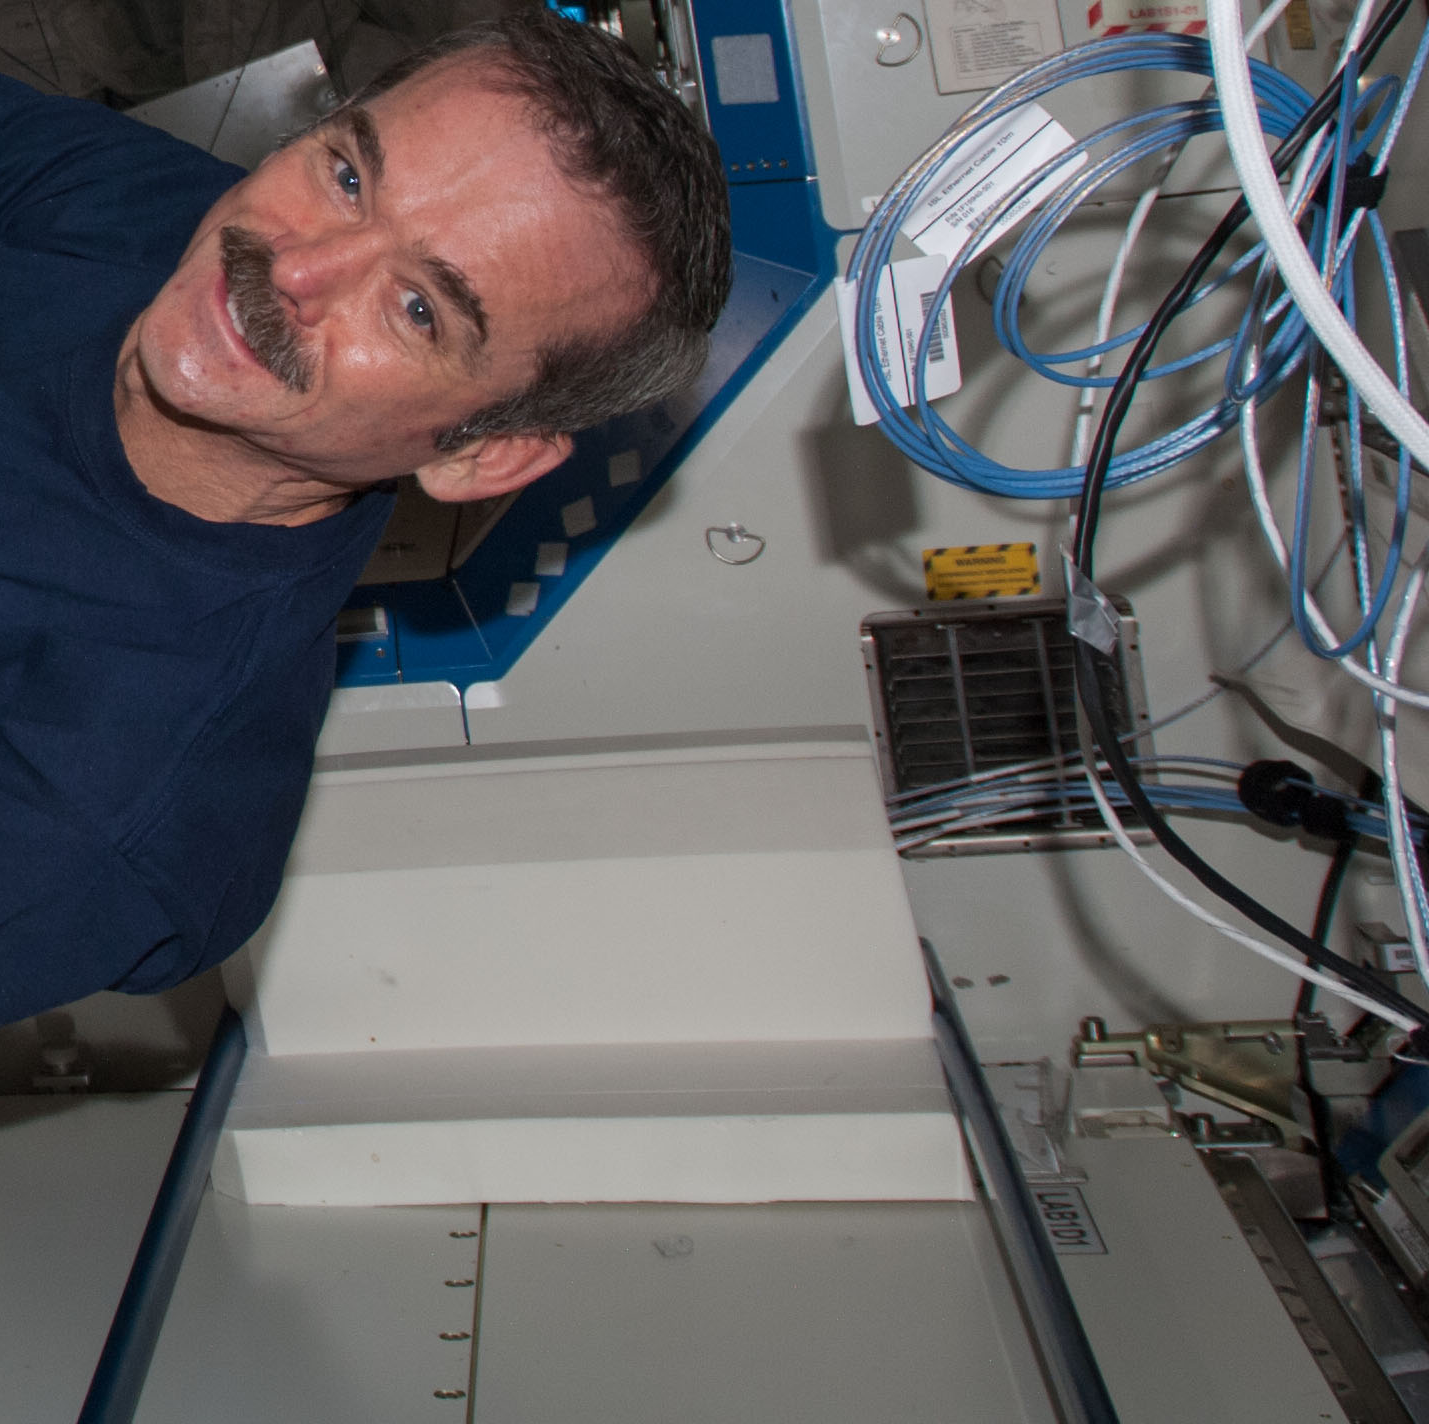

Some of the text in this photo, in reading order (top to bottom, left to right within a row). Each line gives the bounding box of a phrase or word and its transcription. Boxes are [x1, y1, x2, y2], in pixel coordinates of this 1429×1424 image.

[928, 131, 1015, 208] ISL Ethernet Cable 10m
[876, 315, 886, 337] Cable
[878, 338, 890, 368] Ethernet
[955, 556, 1007, 567] WARNING
[1036, 1192, 1094, 1246] LAB1D1
